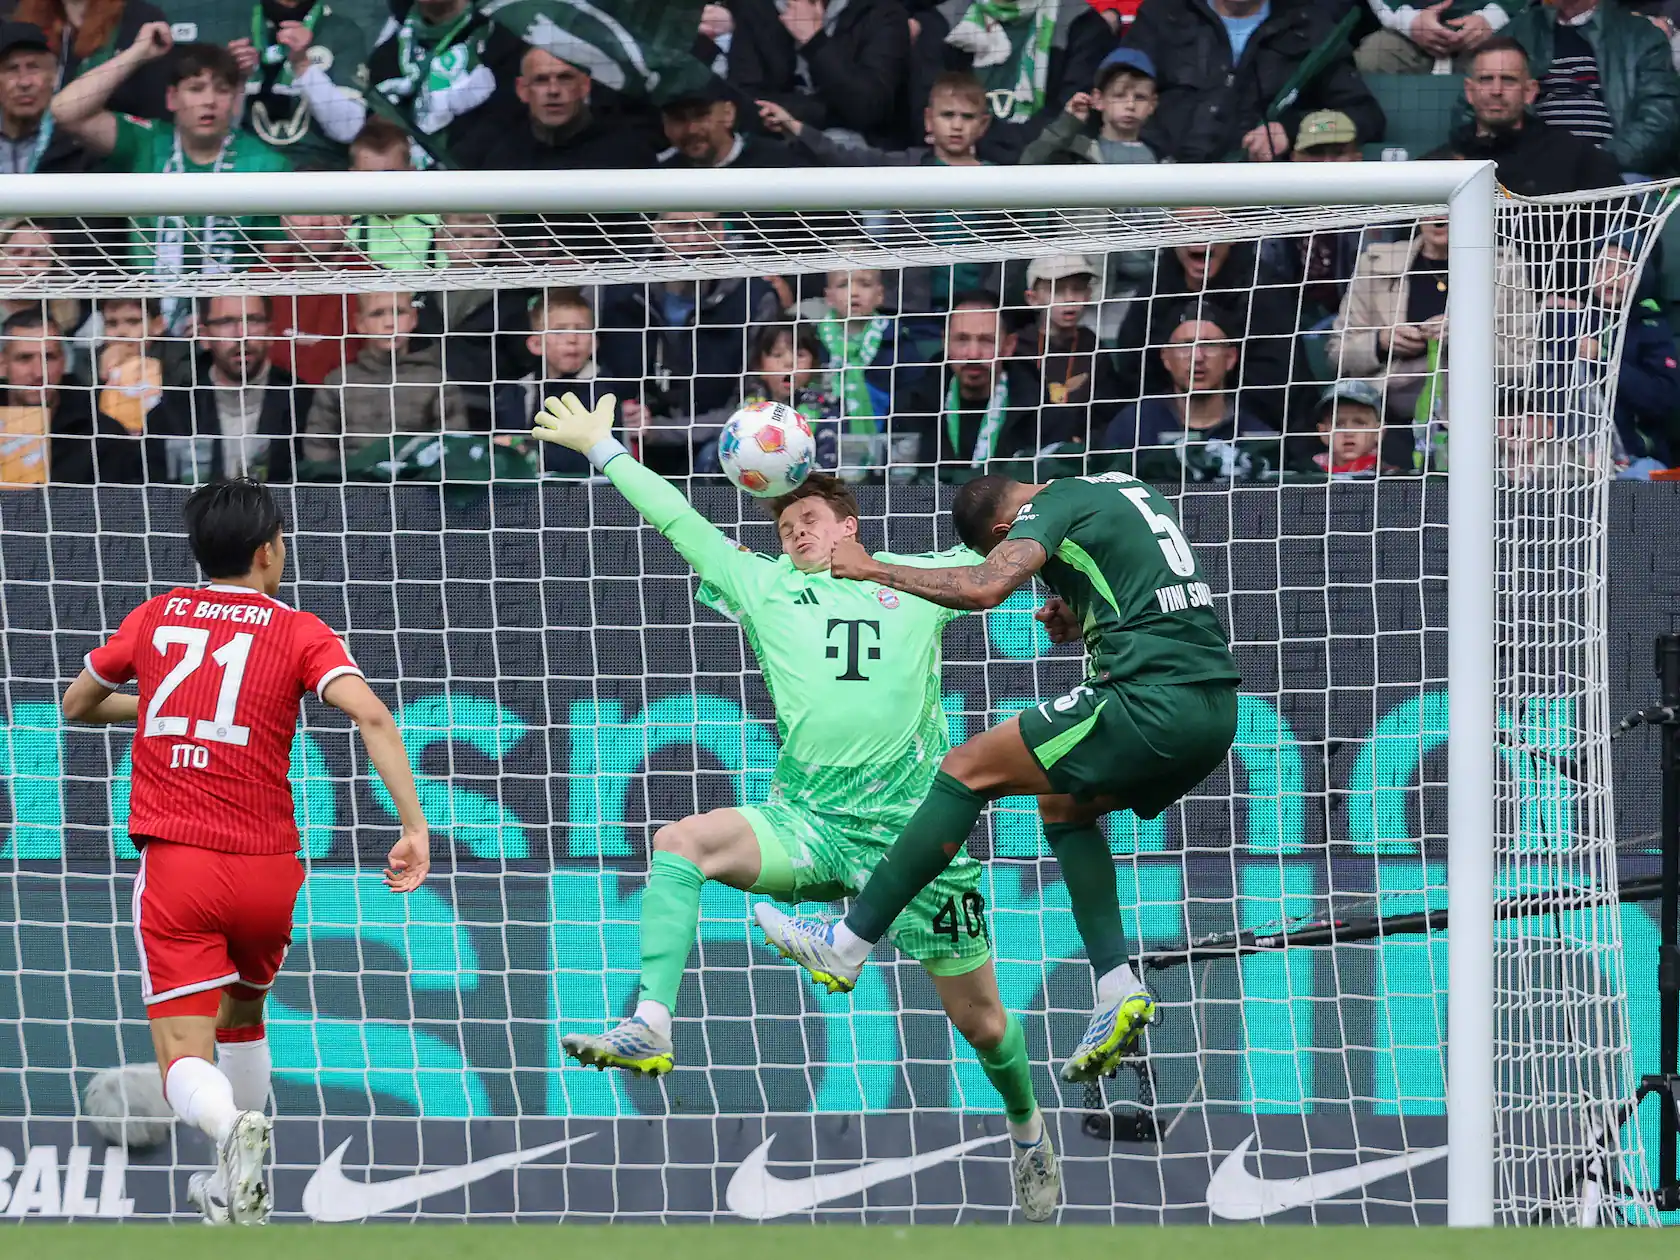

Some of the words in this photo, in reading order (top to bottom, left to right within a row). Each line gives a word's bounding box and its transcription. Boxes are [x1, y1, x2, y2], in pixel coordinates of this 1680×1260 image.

[1118, 486, 1196, 577] 5
[163, 597, 190, 617] FC
[193, 600, 274, 627] BAYERN
[1155, 584, 1188, 614] VINI
[826, 618, 881, 681] T
[143, 625, 254, 746] 21
[1053, 685, 1094, 712] 5
[170, 743, 209, 769] ITO
[932, 892, 985, 943] 40
